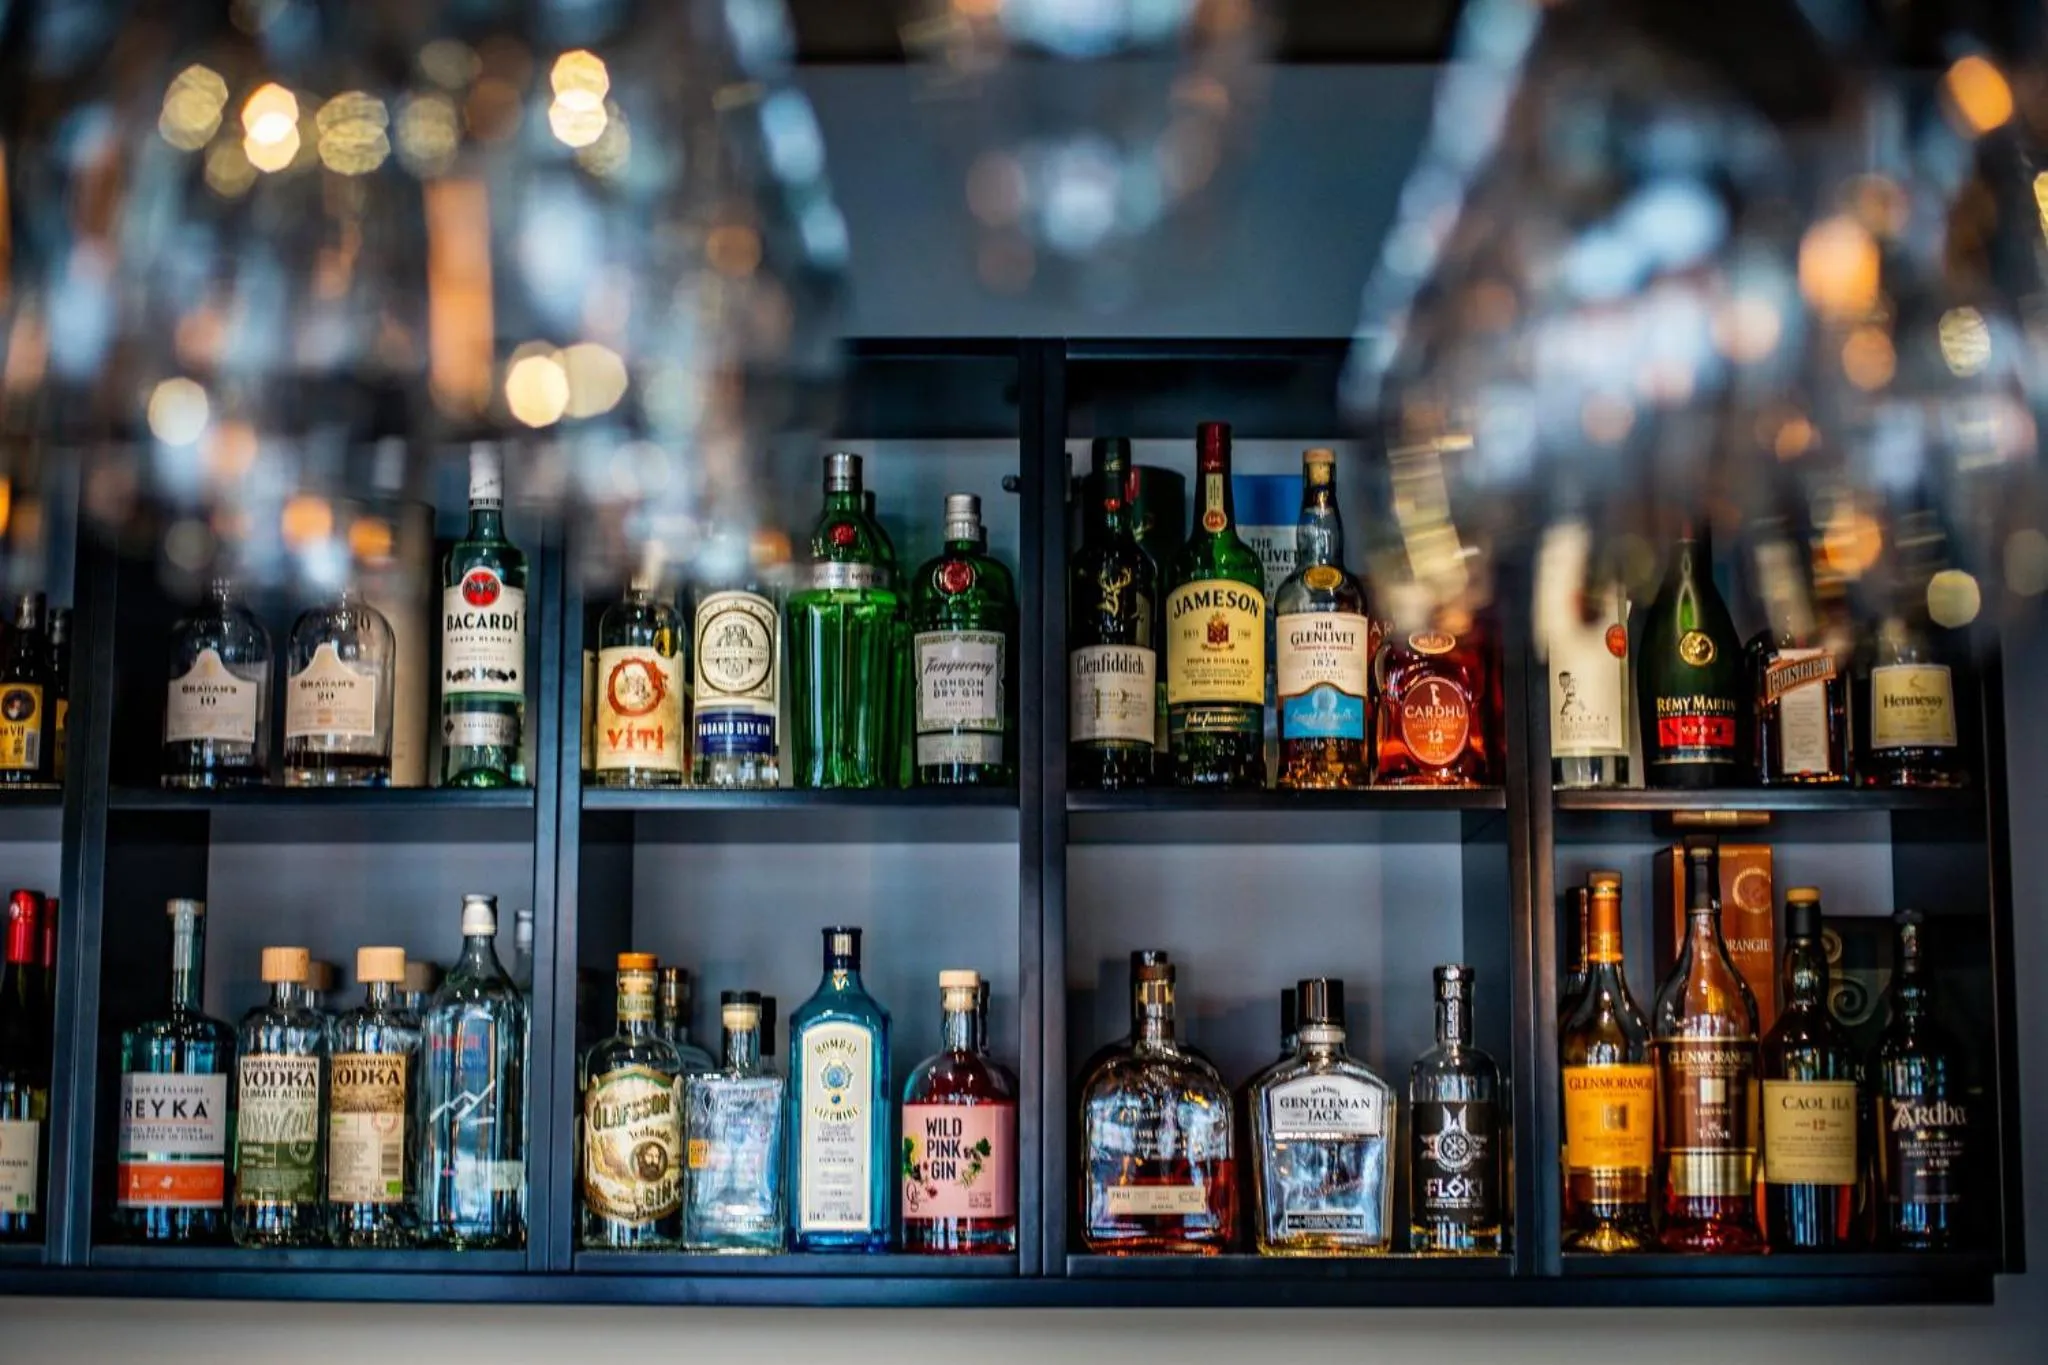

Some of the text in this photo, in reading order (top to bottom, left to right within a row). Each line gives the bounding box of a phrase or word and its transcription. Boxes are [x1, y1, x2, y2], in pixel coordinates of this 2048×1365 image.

[1174, 589, 1260, 619] JAMESON
[447, 610, 519, 633] BACARDÍ
[1315, 621, 1332, 630] THE
[1290, 631, 1354, 645] GLENLIVET
[924, 656, 994, 676] Tanqueray
[1076, 652, 1144, 675] Glenfiddich
[933, 679, 984, 689] LONDON
[933, 688, 984, 699] DRY GIN
[1883, 694, 1942, 709] Hennessy
[1404, 705, 1466, 720] CARDHU
[243, 1071, 316, 1087] VODKA
[124, 1099, 208, 1119] REYKA
[1280, 1096, 1371, 1108] GENTLEMAN
[1782, 1096, 1851, 1110] CAOL ILA
[1308, 1109, 1342, 1122] JACK
[926, 1117, 962, 1137] WILD
[926, 1139, 962, 1159] PINK
[931, 1160, 956, 1180] GIN
[643, 1183, 672, 1207] GIN
